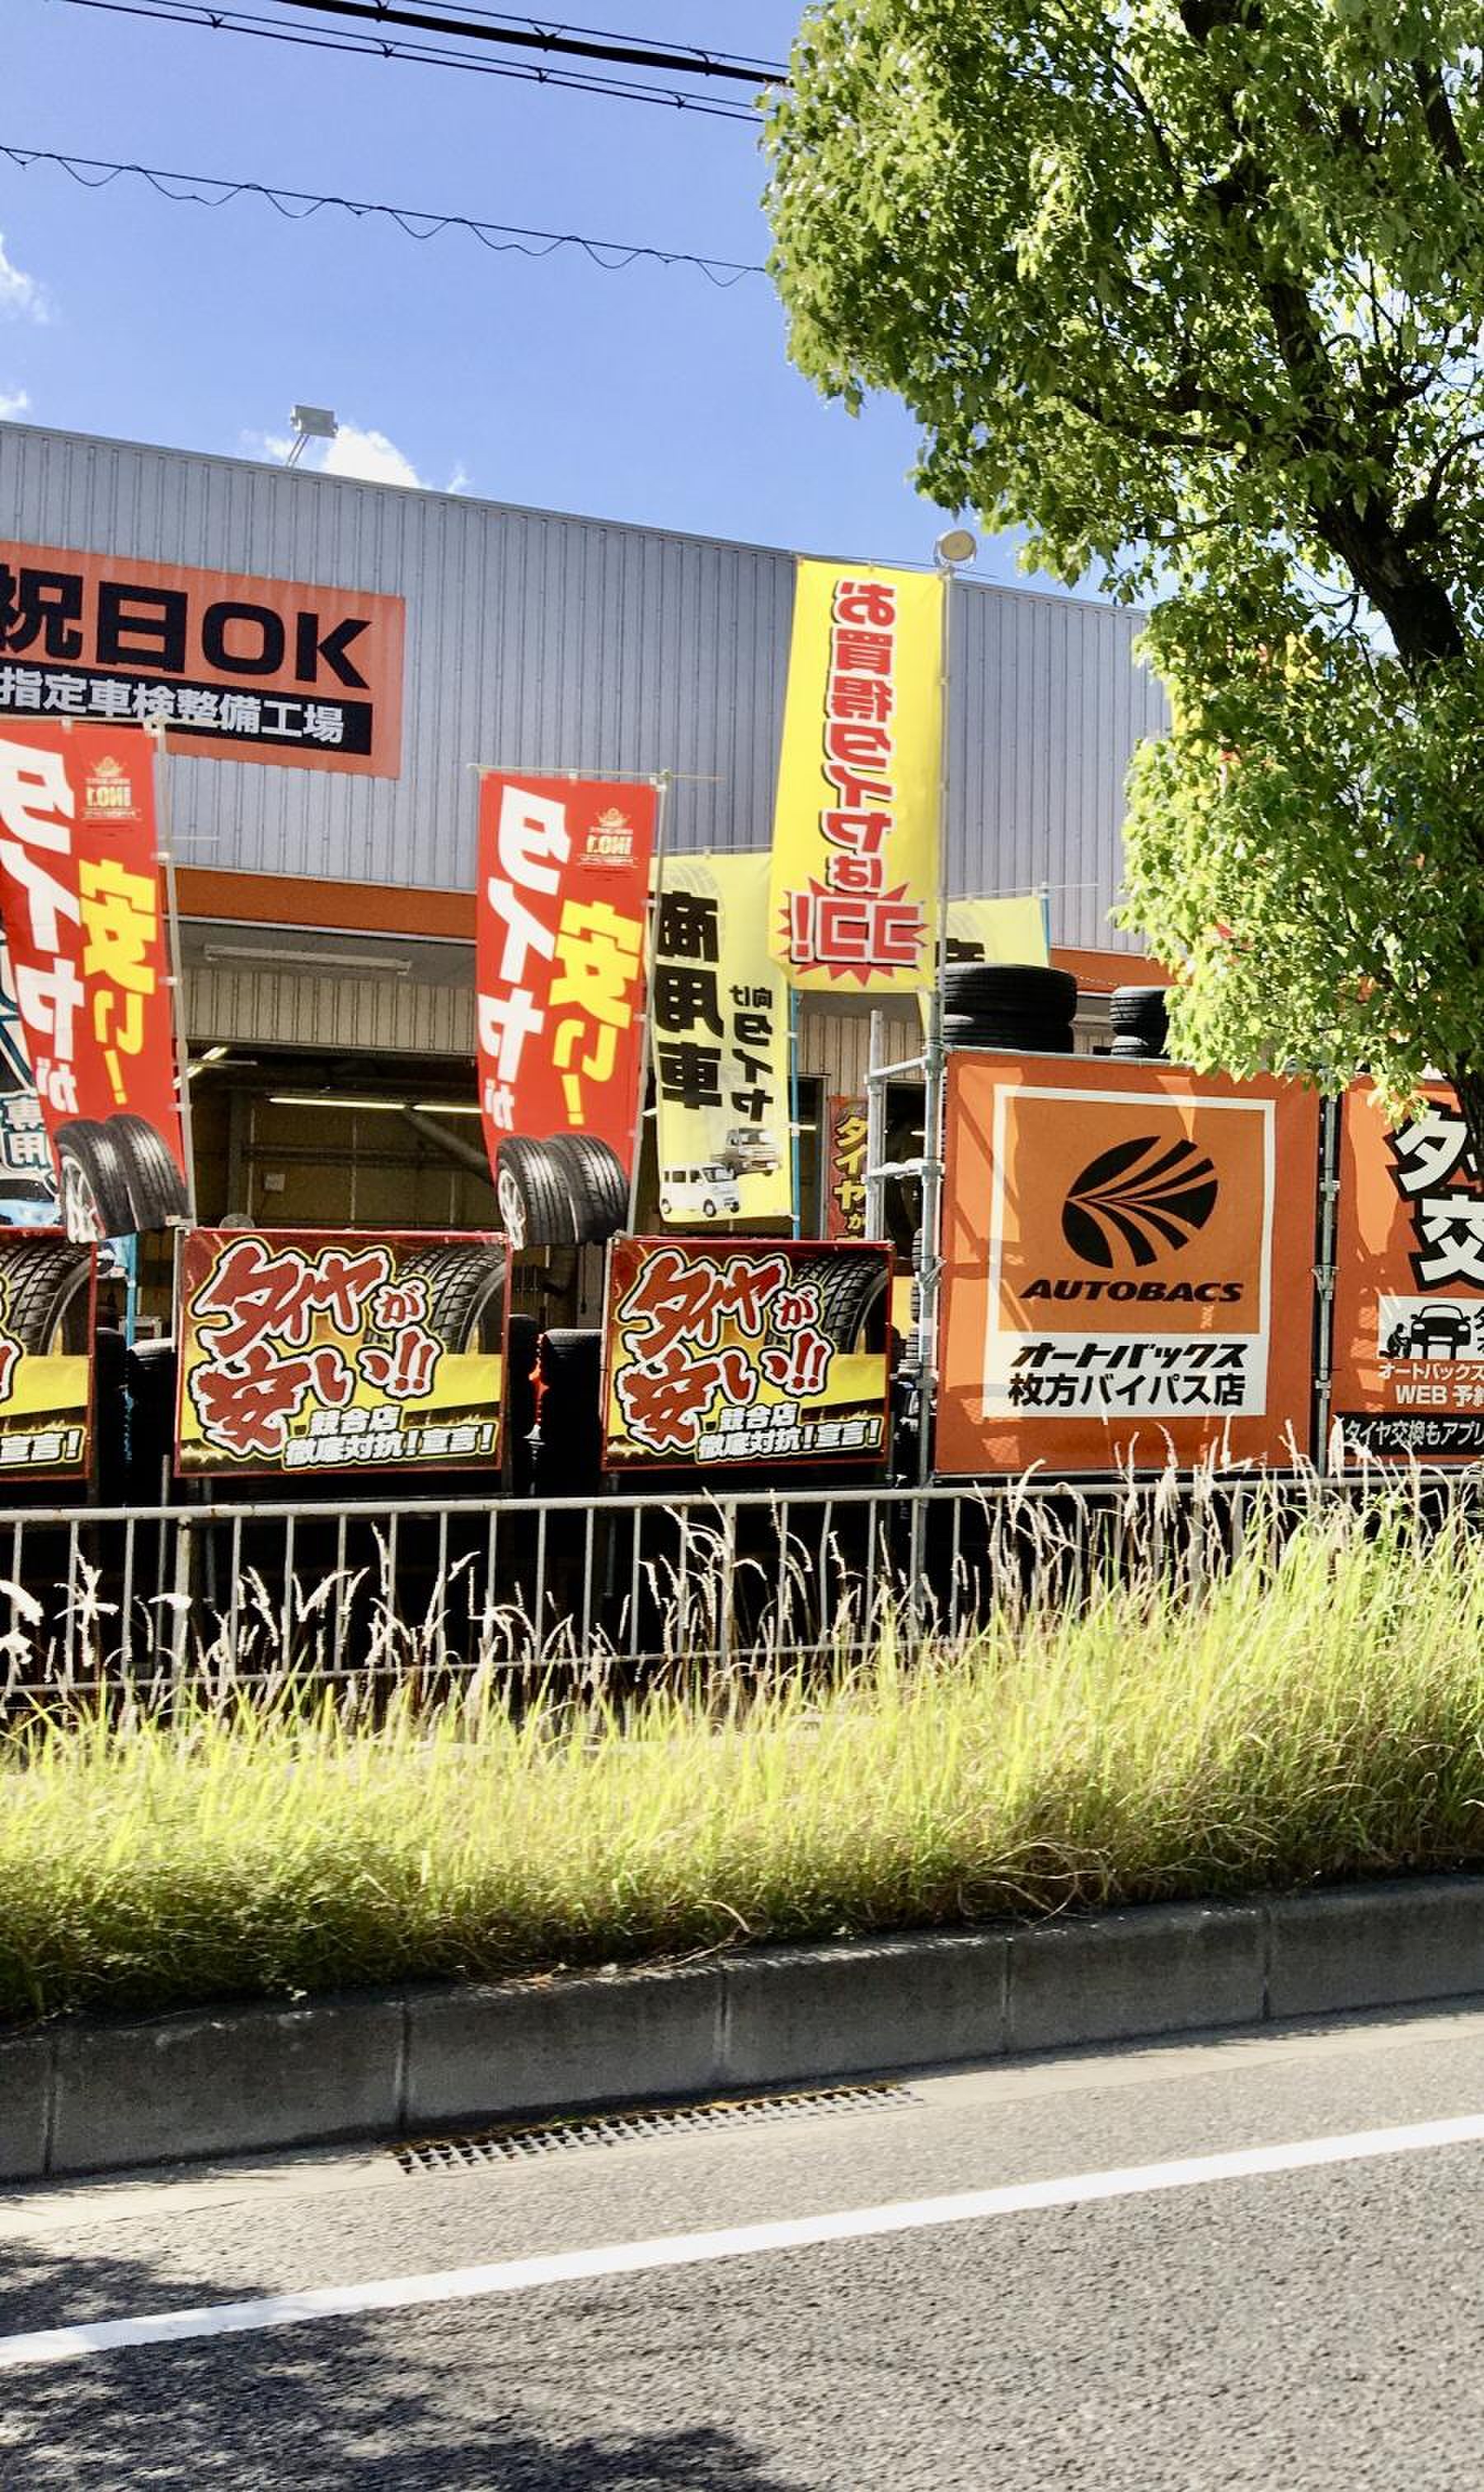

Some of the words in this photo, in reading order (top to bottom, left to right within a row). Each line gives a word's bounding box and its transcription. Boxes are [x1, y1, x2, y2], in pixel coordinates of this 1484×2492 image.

[0, 564, 373, 689] 祝日OK
[0, 667, 344, 743] 指定車検整備工場
[834, 1116, 868, 1240] タイヤが
[1394, 1108, 1478, 1192] タ
[195, 1240, 427, 1362] タイヤが
[621, 1249, 819, 1361] タイヤが
[1020, 1279, 1243, 1302] AUTOBACS
[1008, 1373, 1247, 1407] 枚方バイパス店
[1012, 1342, 1249, 1369] オートバックス
[1396, 1385, 1448, 1404] WEB
